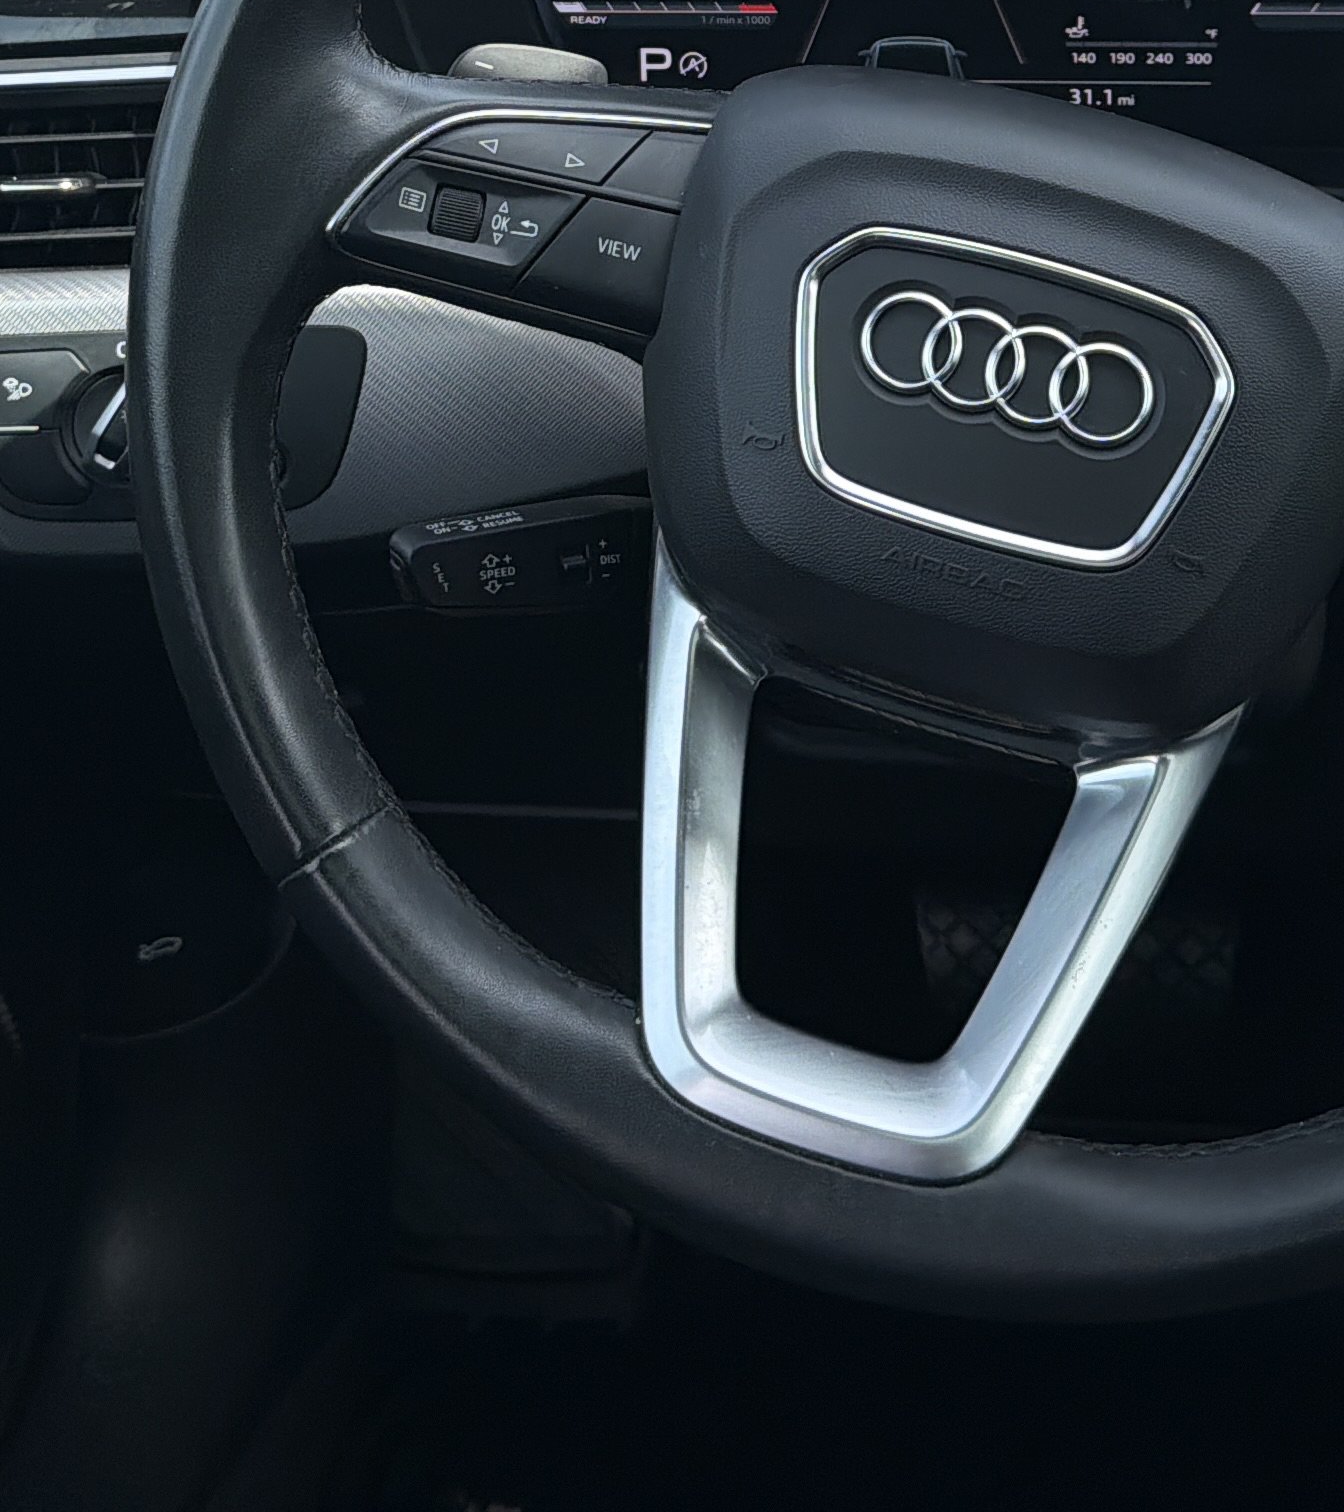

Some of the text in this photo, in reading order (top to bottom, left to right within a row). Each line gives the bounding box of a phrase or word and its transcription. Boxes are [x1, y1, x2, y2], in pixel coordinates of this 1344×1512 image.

[570, 16, 608, 24] READY
[746, 16, 771, 24] 1000
[640, 47, 672, 82] P
[1071, 52, 1213, 66] 140 190 240 300
[1069, 88, 1135, 107] 31.1 mi
[491, 213, 509, 232] OK
[598, 236, 641, 262] VIEW
[426, 511, 520, 531] OFF CANCEL
[434, 516, 524, 535] ON RESUME
[600, 555, 620, 565] DIST
[480, 567, 516, 580] SPEED
